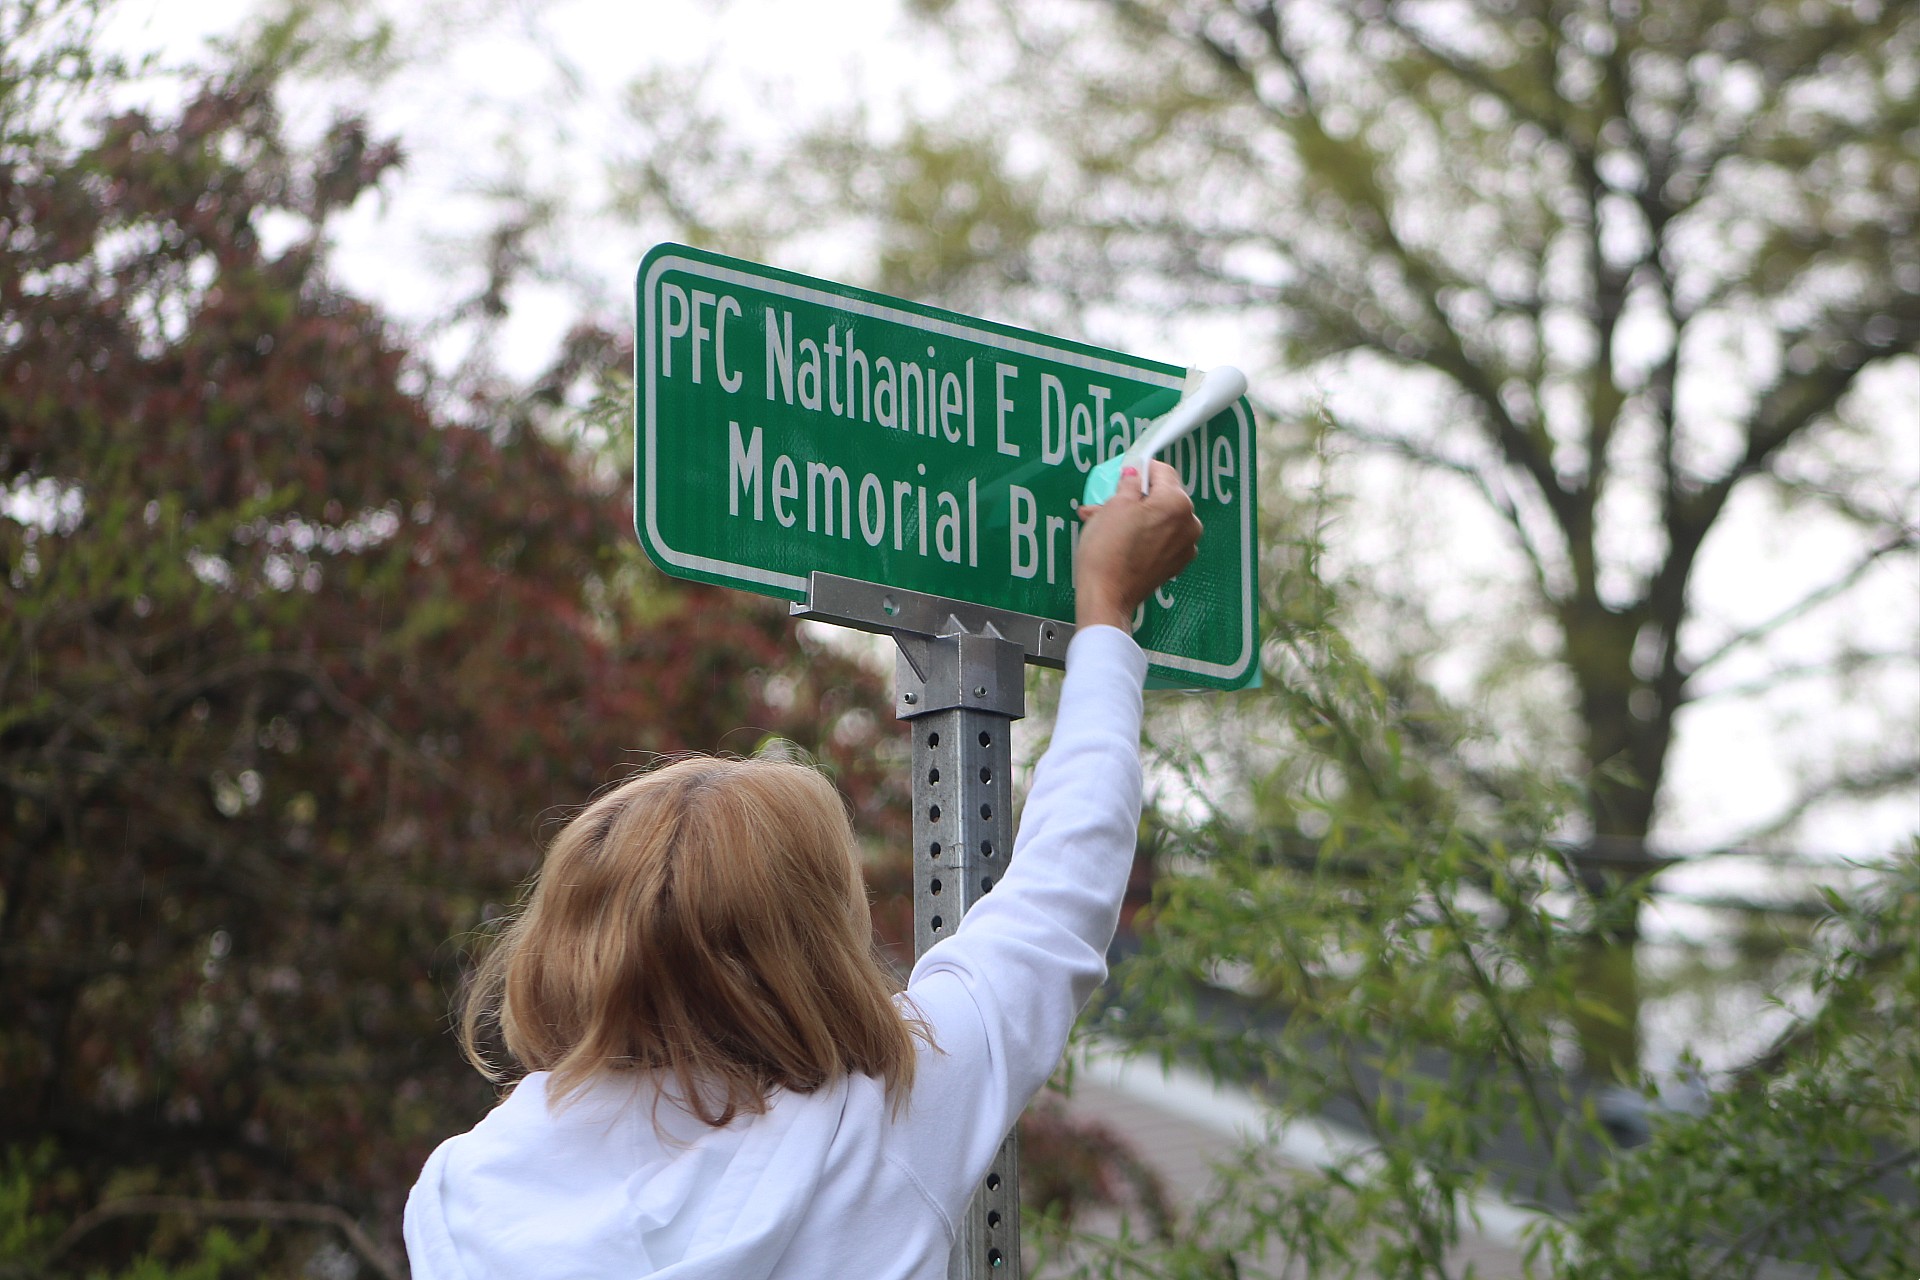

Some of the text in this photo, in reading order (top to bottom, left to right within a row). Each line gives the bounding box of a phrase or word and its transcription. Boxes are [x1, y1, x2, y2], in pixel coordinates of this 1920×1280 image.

[661, 282, 743, 394] PFC
[765, 306, 976, 447] Nathaniel
[995, 362, 1021, 458] E
[728, 420, 1176, 634] Memorial Bri
